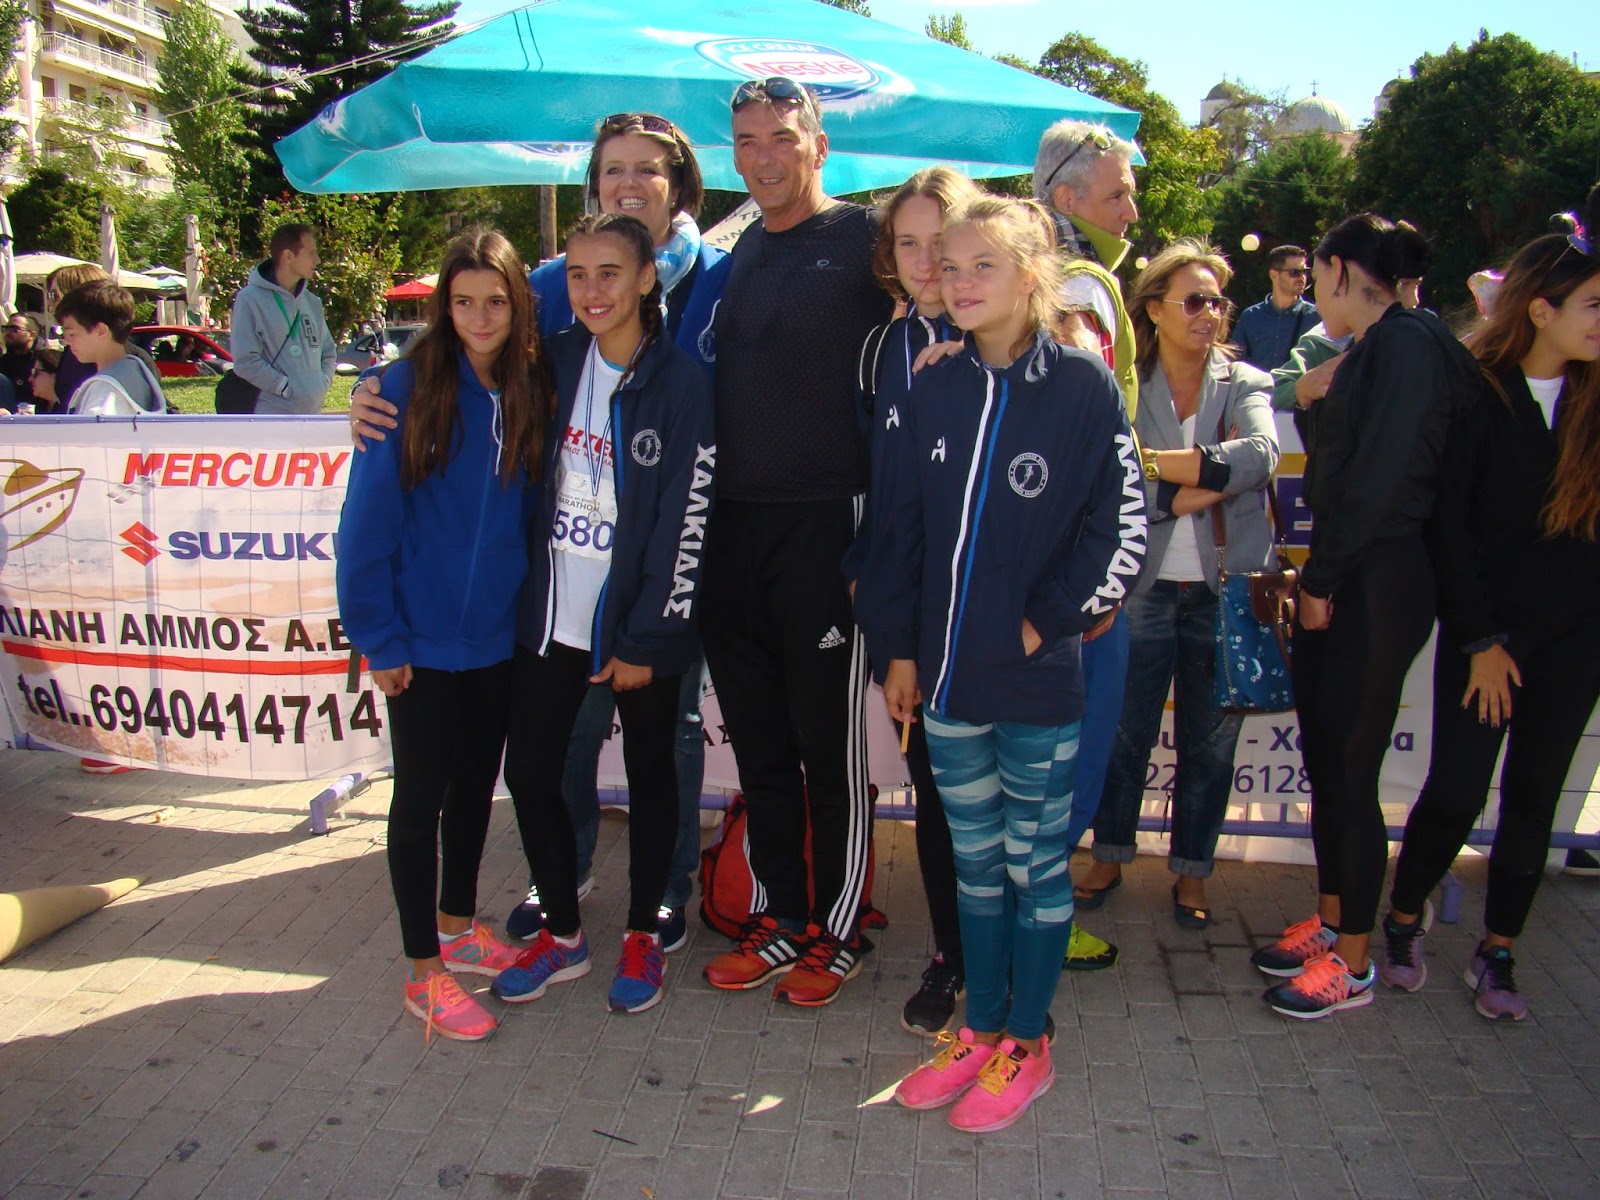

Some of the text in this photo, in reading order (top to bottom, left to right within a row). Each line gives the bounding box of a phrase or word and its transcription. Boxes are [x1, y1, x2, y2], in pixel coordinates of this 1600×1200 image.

[124, 453, 350, 487] MERCURY
[551, 509, 616, 552] 580
[662, 442, 717, 619] ΧΑΛΚΙΔΑΣ
[120, 613, 269, 652] ΑΜΜΟΣ
